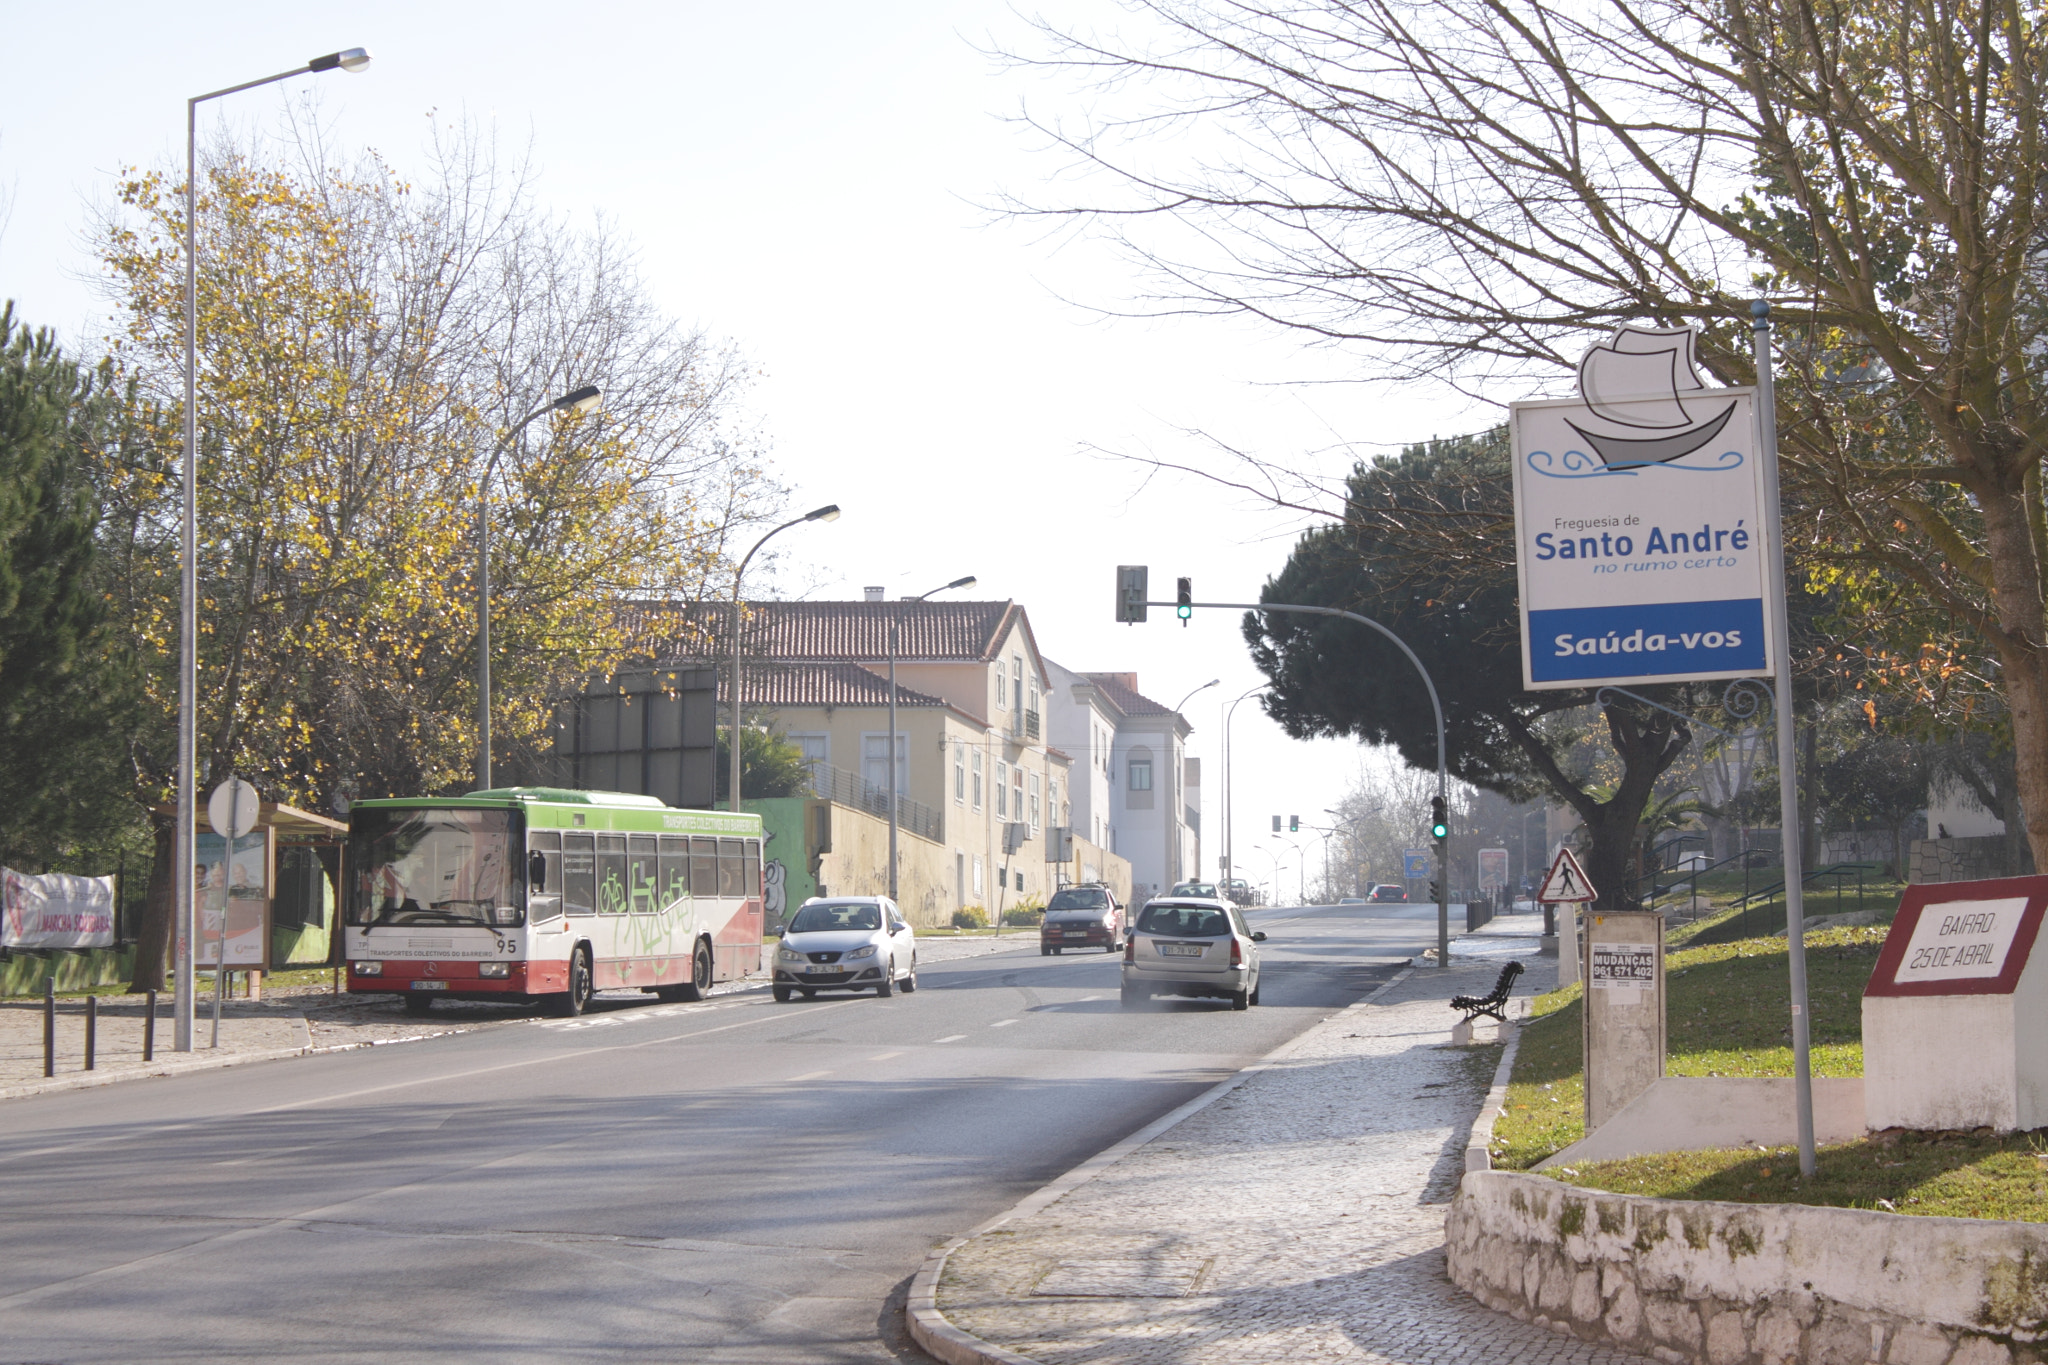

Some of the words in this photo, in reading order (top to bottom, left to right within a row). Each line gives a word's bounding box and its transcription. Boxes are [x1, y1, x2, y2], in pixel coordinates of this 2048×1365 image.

[1554, 517, 1620, 532] Freguesia
[1624, 514, 1640, 526] de
[1535, 532, 1634, 561] Santo
[1645, 520, 1749, 555] André
[1593, 563, 1618, 574] no
[1624, 559, 1678, 572] rumo
[1683, 555, 1737, 569] certo
[1554, 629, 1742, 657] Saúda-vos
[43, 914, 72, 933] MARCHA
[1939, 912, 1996, 936] BAIRRO
[497, 939, 517, 954] 95
[1910, 947, 1935, 969] 25
[1931, 946, 1956, 968] DE
[1952, 943, 1994, 966] ABRIL
[1594, 955, 1652, 968] MUDANÇAS
[1594, 966, 1611, 976] 961
[1614, 966, 1631, 976] 571
[1634, 966, 1652, 977] 402
